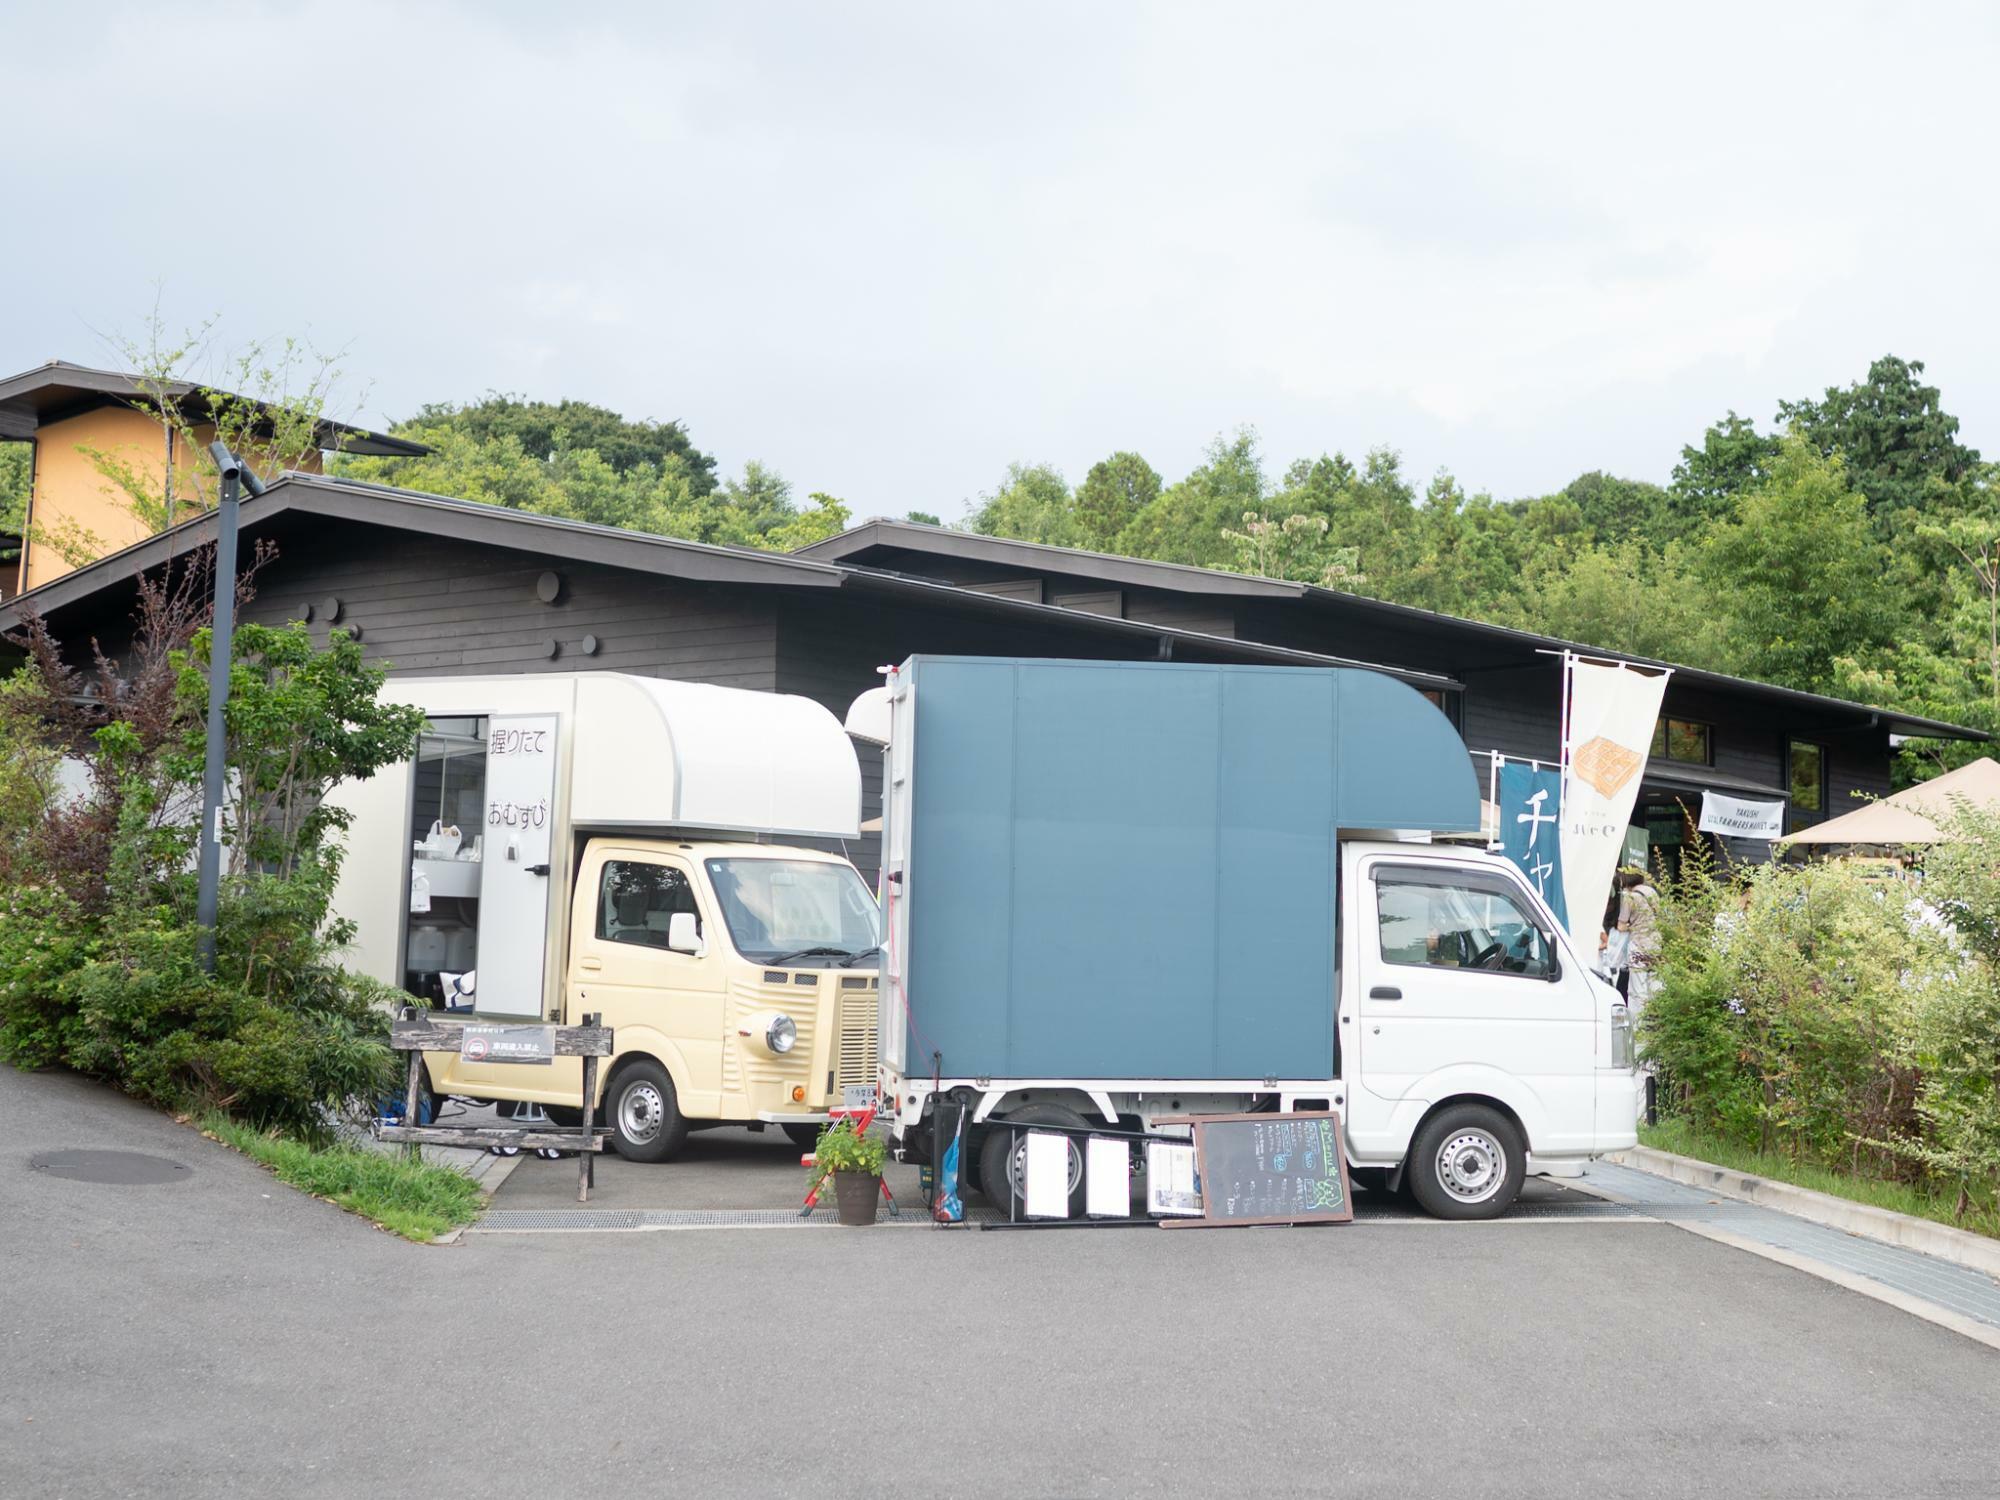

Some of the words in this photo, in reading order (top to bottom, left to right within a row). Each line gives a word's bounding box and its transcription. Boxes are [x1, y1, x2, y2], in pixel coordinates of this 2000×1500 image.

[490, 729, 546, 755] 握りたて
[488, 799, 547, 829] おむすび
[1323, 1131, 1335, 1166] Menu
